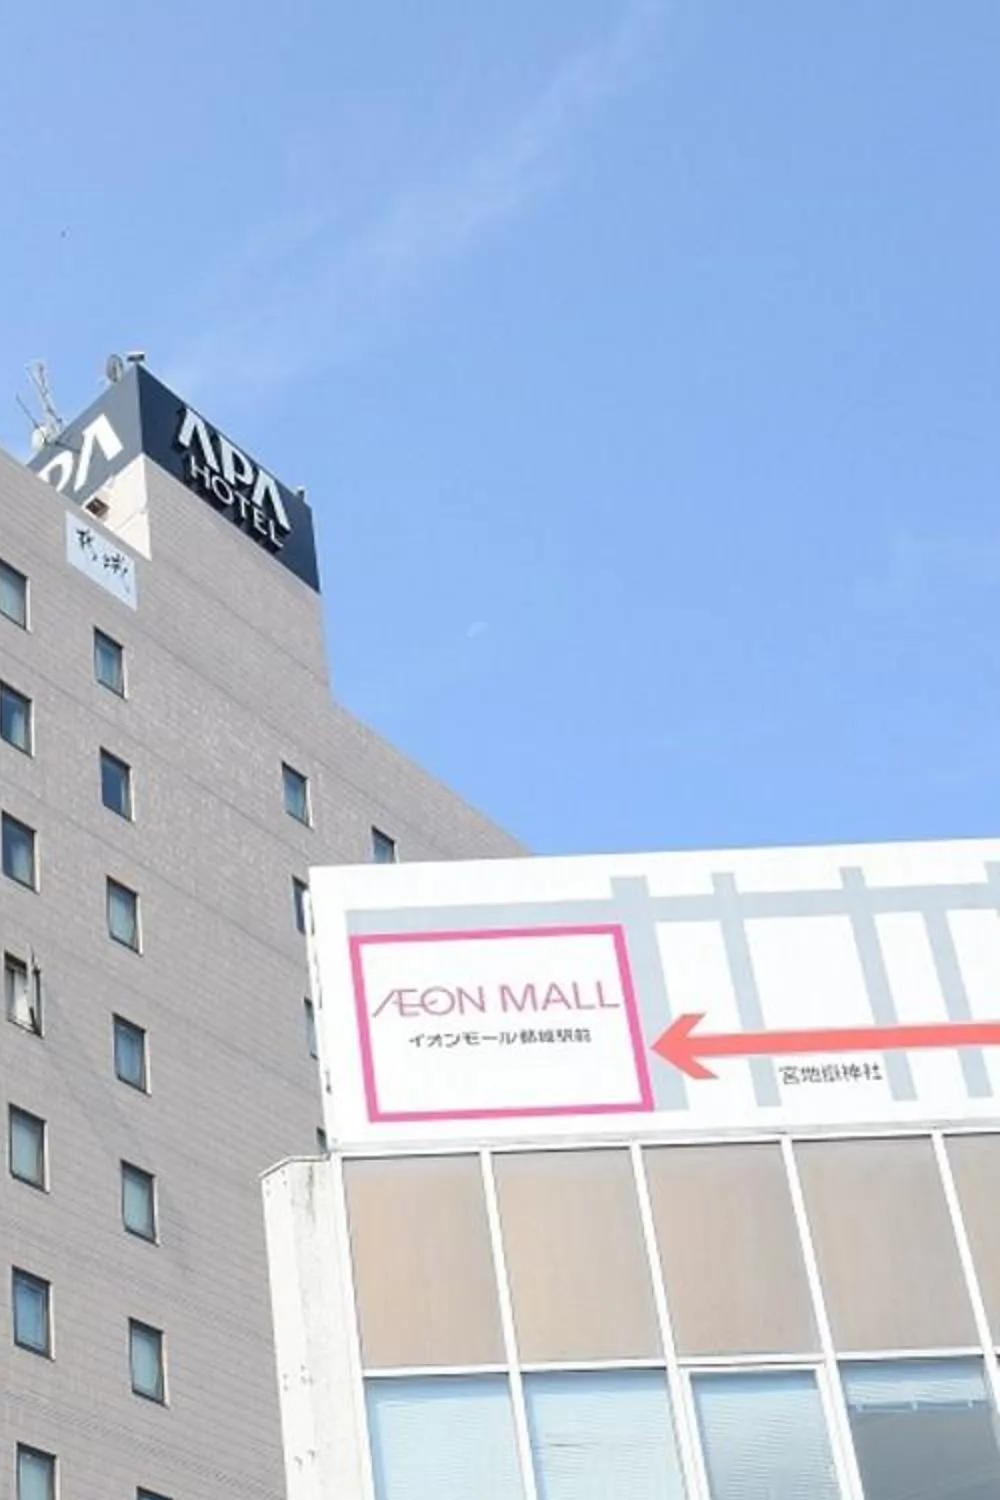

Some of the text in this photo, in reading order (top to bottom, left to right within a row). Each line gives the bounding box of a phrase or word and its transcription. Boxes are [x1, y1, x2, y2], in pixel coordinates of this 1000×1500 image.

[178, 407, 291, 532] APA
[190, 455, 284, 549] HOTEL
[499, 980, 621, 1013] MALL
